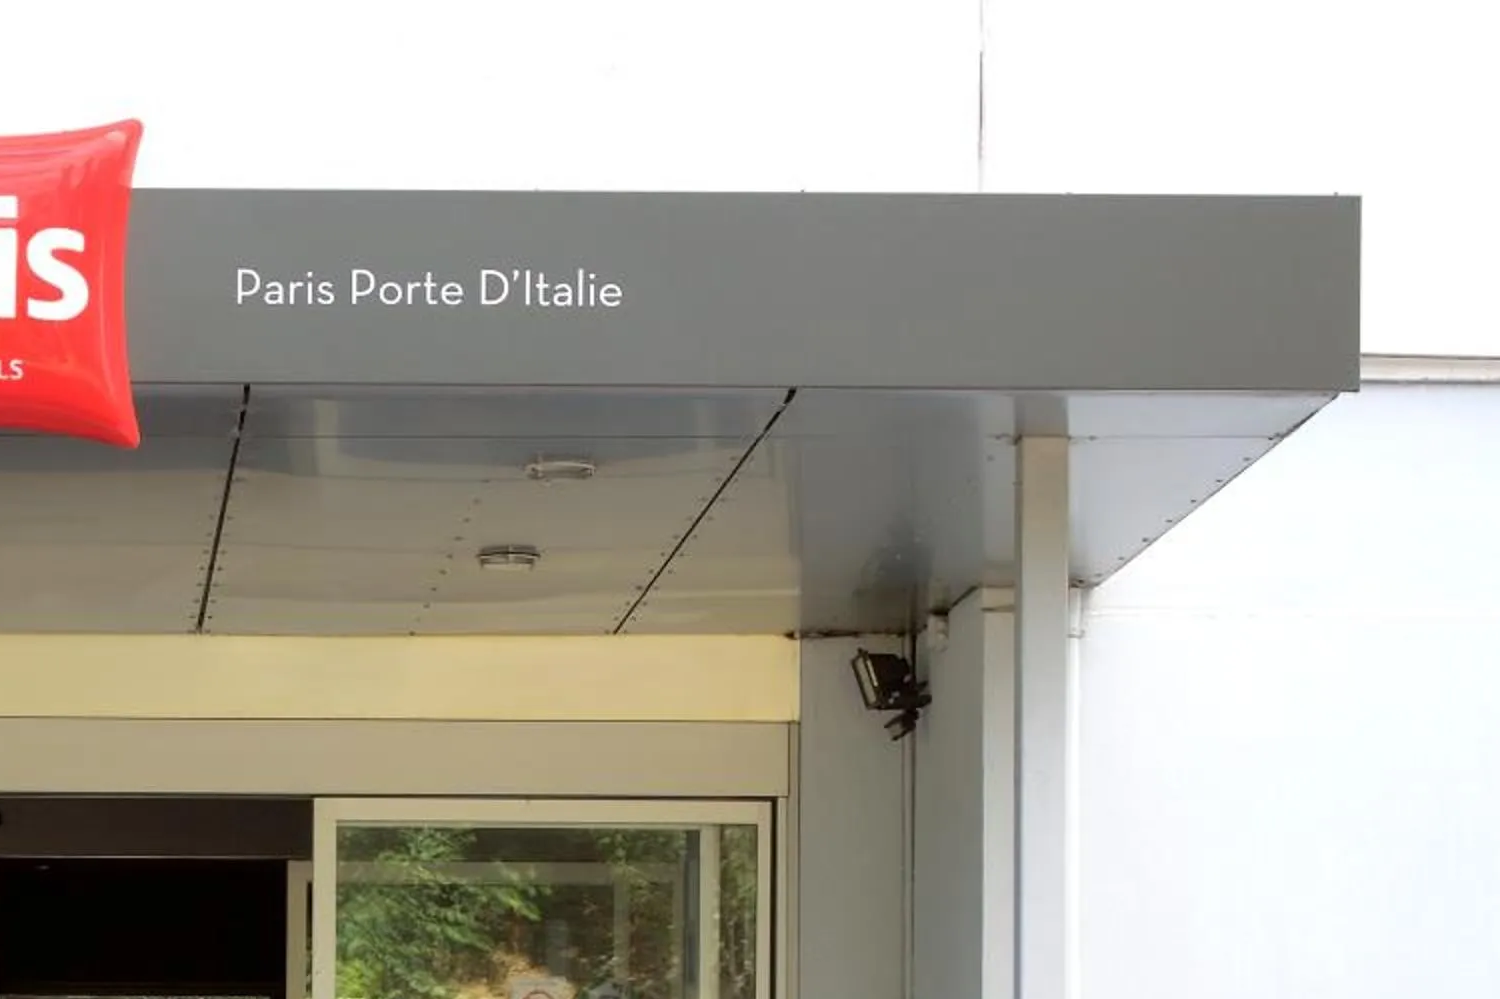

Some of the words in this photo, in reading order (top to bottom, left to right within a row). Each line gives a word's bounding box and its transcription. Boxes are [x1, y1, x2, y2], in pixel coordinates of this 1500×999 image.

[236, 268, 336, 305] Paris
[350, 268, 465, 306] Porte
[480, 268, 624, 307] D'Italie
